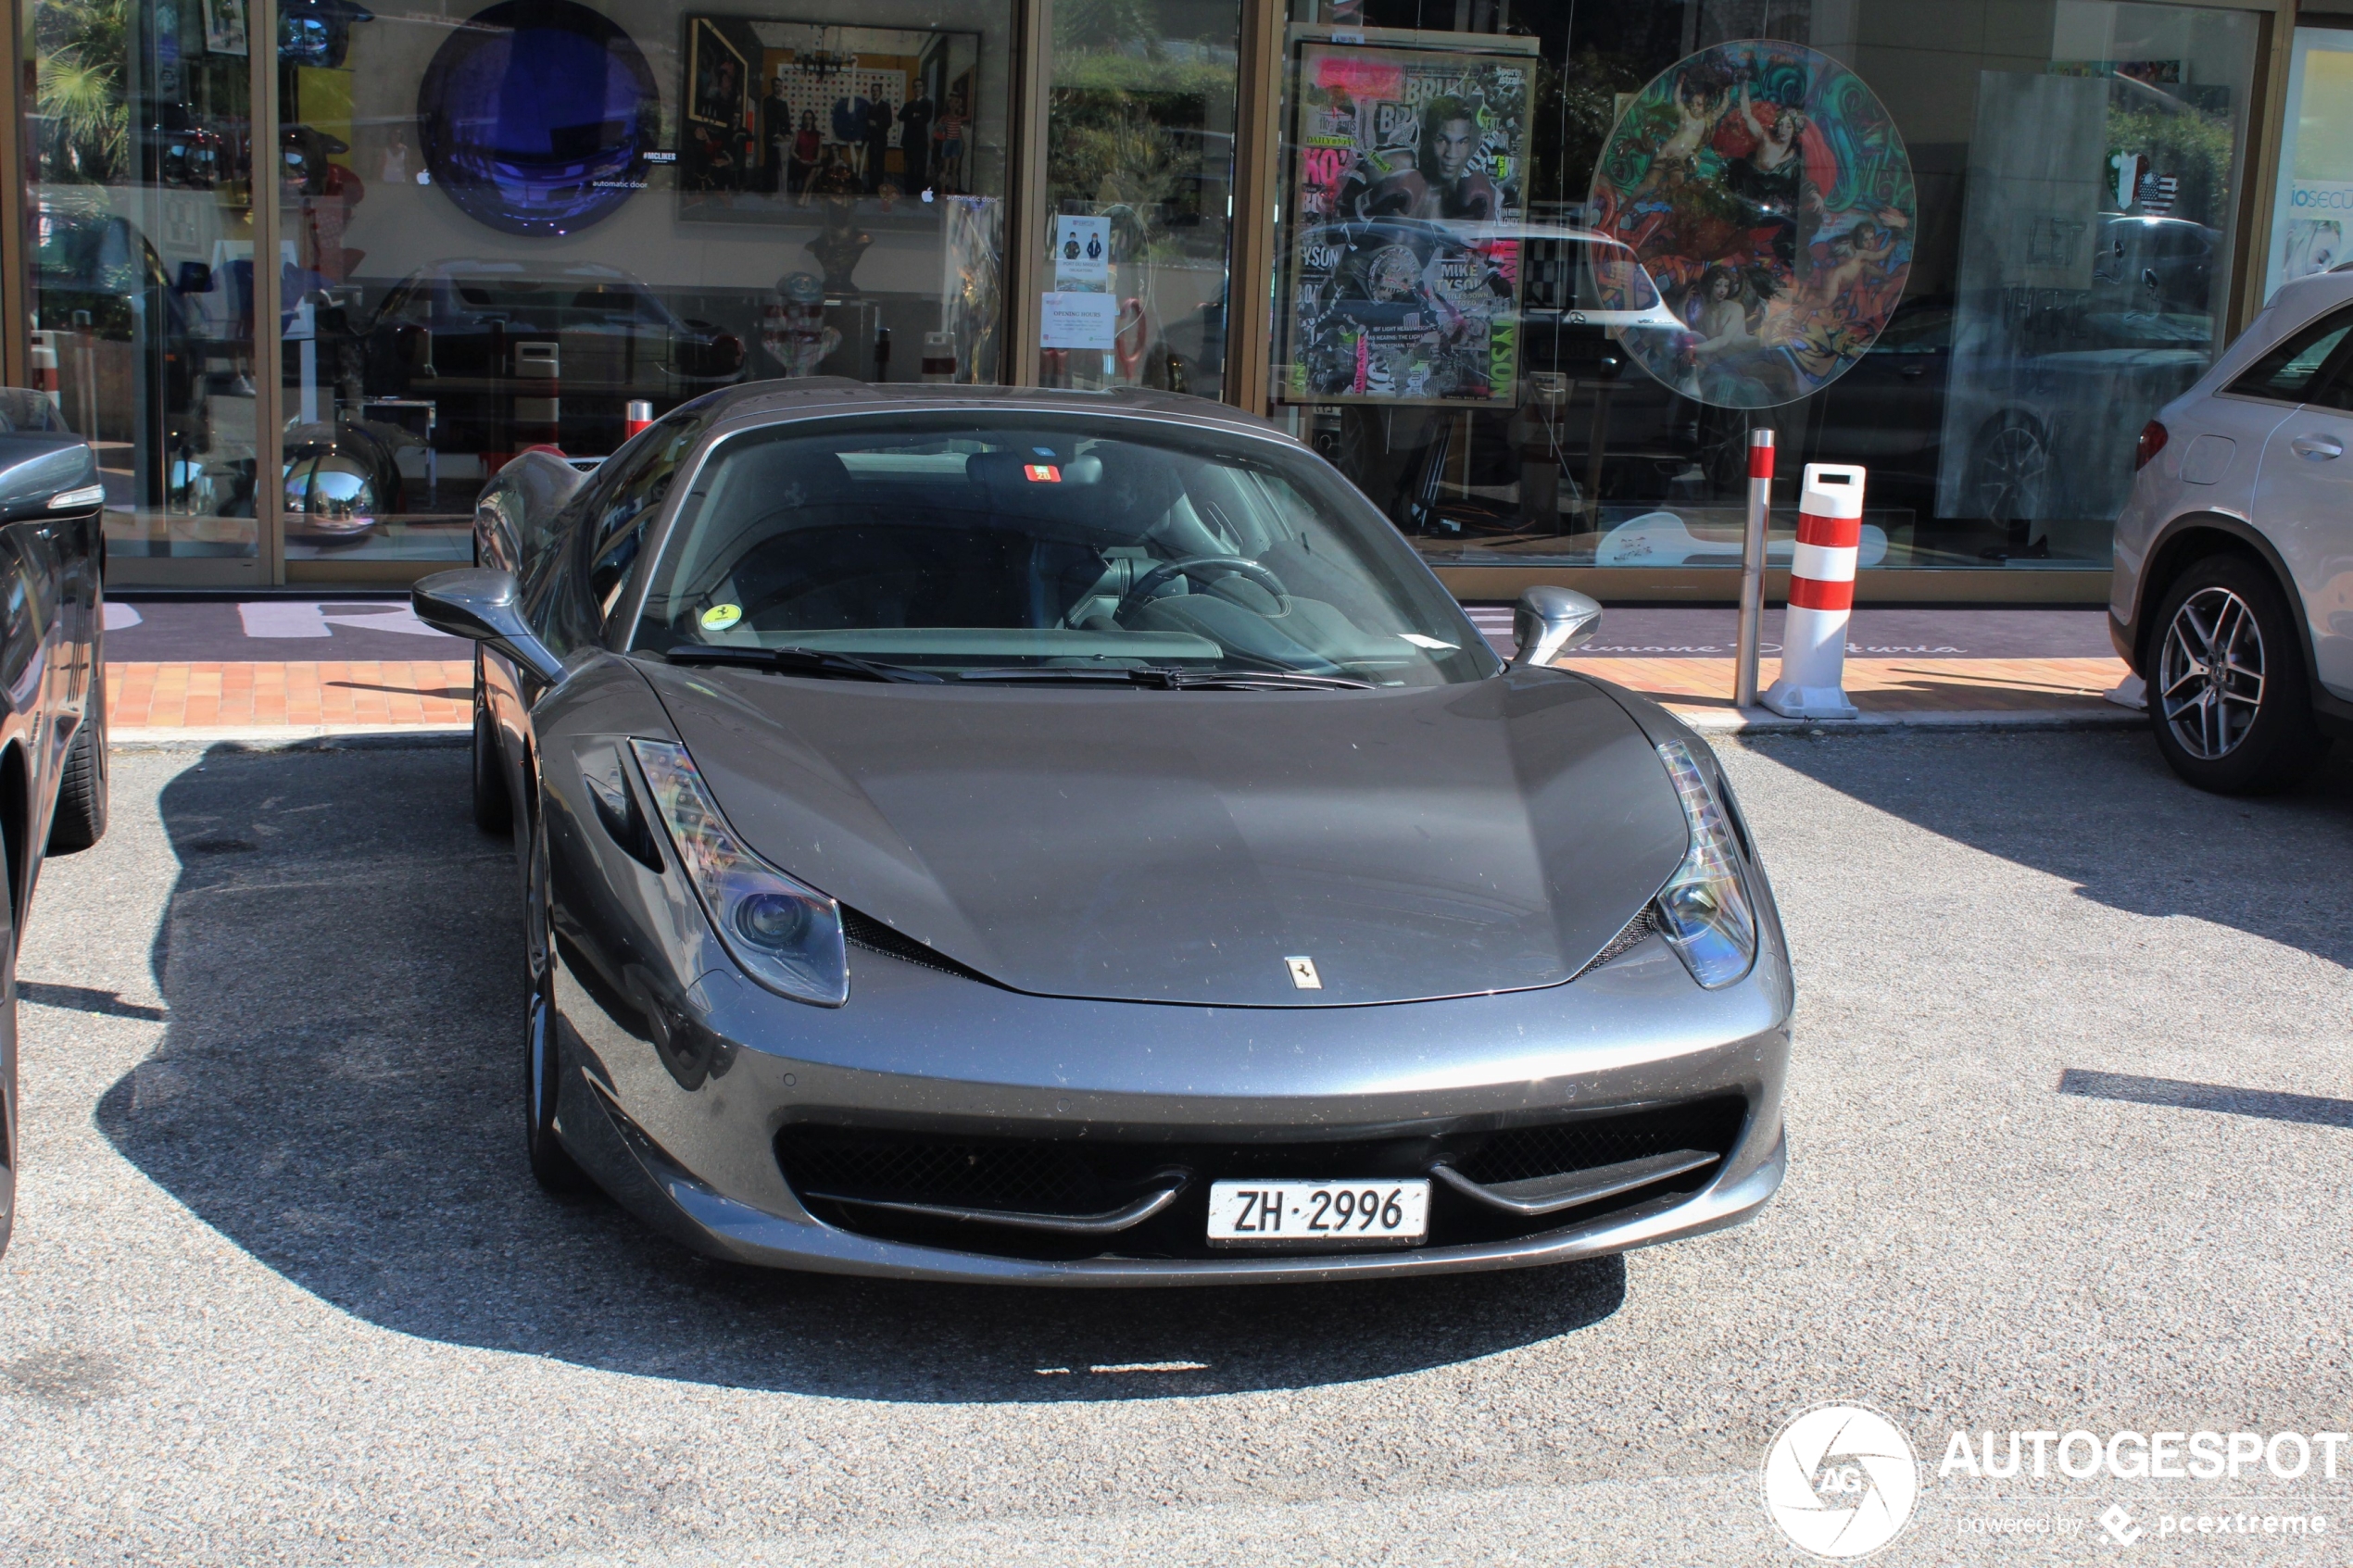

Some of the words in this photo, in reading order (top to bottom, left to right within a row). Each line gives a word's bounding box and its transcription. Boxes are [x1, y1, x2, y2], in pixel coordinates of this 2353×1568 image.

[629, 181, 648, 189] door
[946, 194, 980, 203] automatic
[1441, 264, 1478, 277] MIKE
